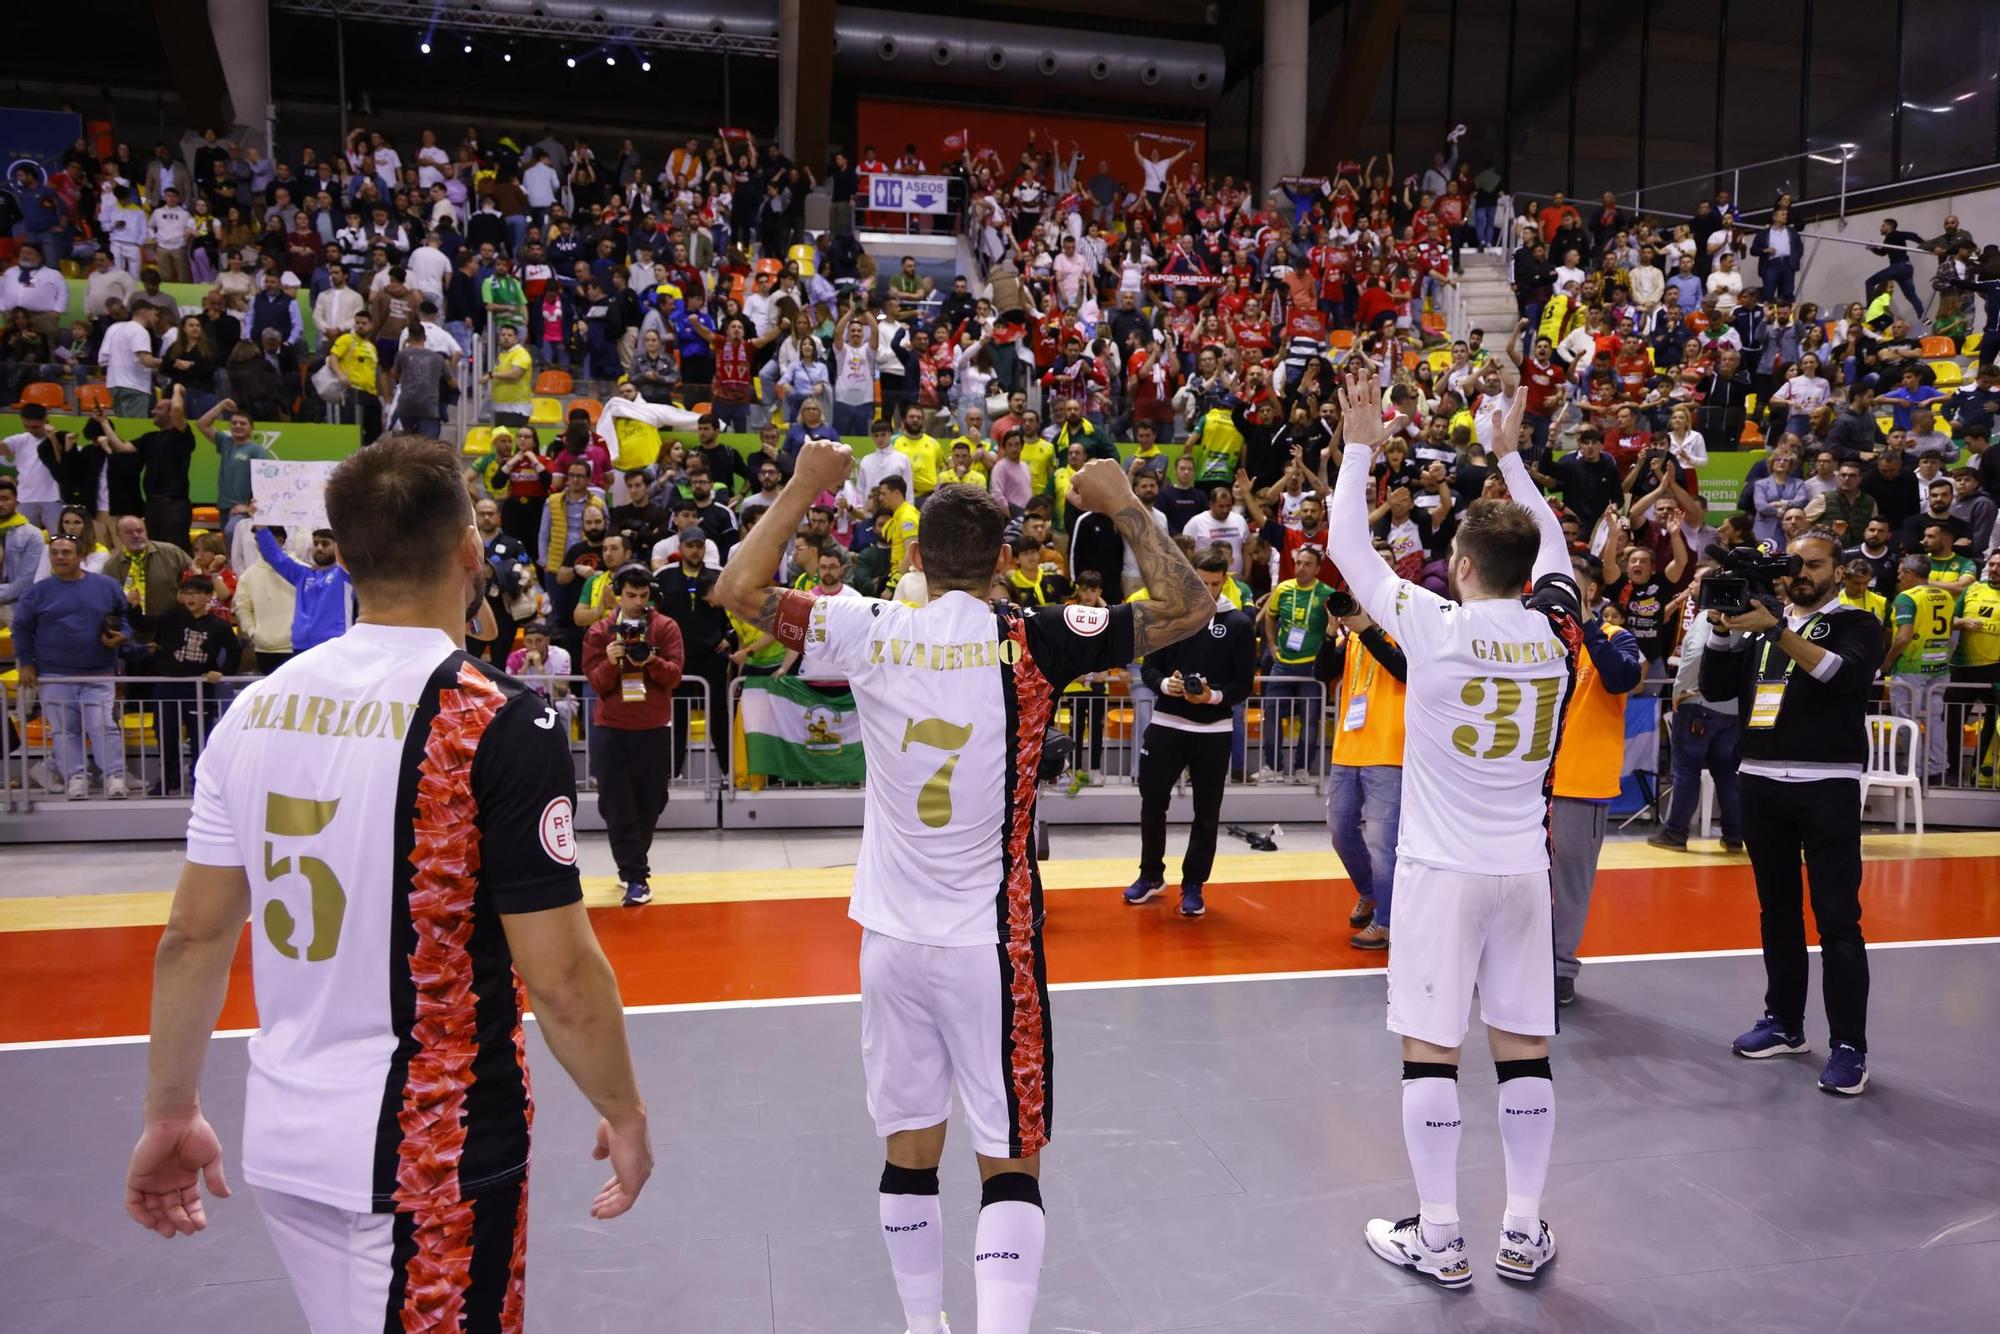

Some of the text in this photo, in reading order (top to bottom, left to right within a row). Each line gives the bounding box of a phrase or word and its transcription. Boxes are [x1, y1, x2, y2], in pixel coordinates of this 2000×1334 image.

[905, 182, 945, 193] ASEOS
[1181, 275, 1210, 283] MURCIA
[1932, 604, 1947, 635] 5
[242, 694, 420, 740] MARLON
[1452, 676, 1560, 762] 31
[901, 718, 973, 828] 7
[264, 791, 347, 962] 5
